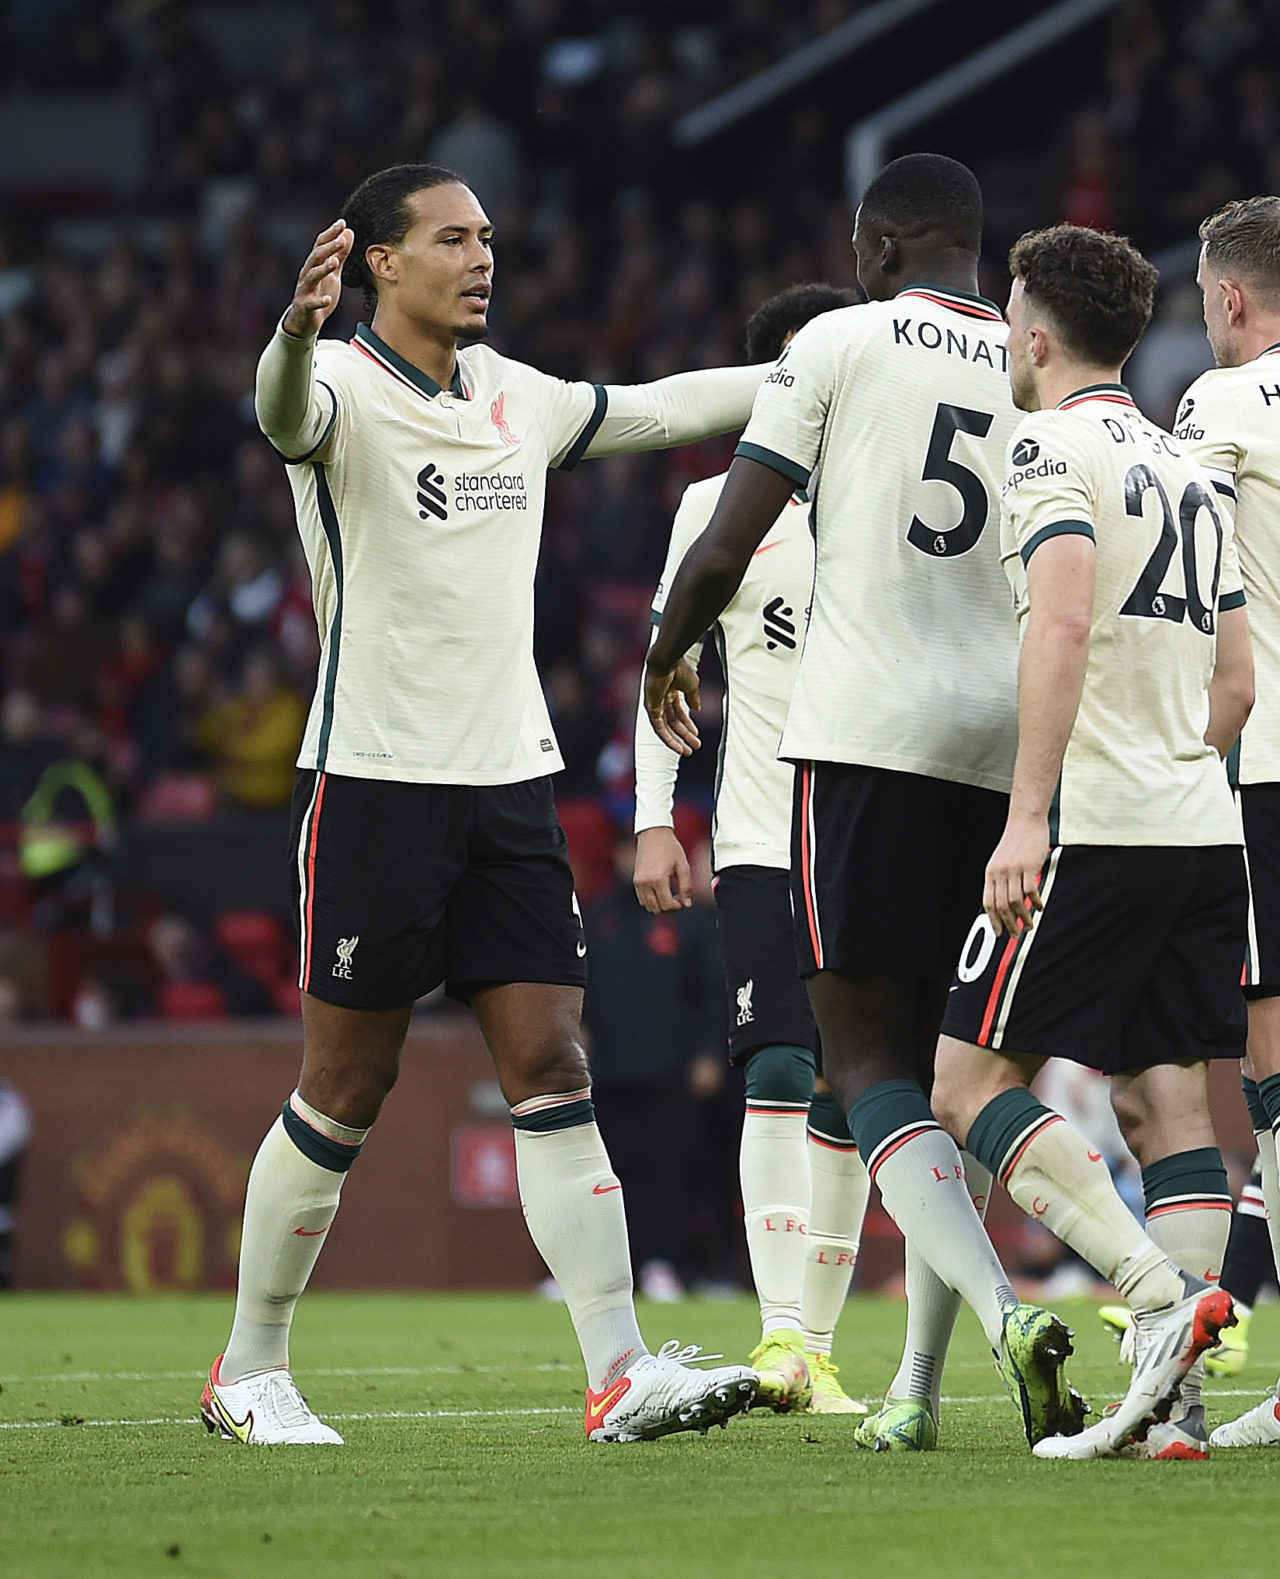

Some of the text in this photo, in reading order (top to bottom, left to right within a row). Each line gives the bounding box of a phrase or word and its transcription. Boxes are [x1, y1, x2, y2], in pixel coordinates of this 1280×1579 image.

[454, 472, 525, 491] standard
[906, 402, 995, 559] 5
[455, 491, 528, 511] chartered
[1119, 463, 1223, 636] 20
[764, 1218, 807, 1235] LFC
